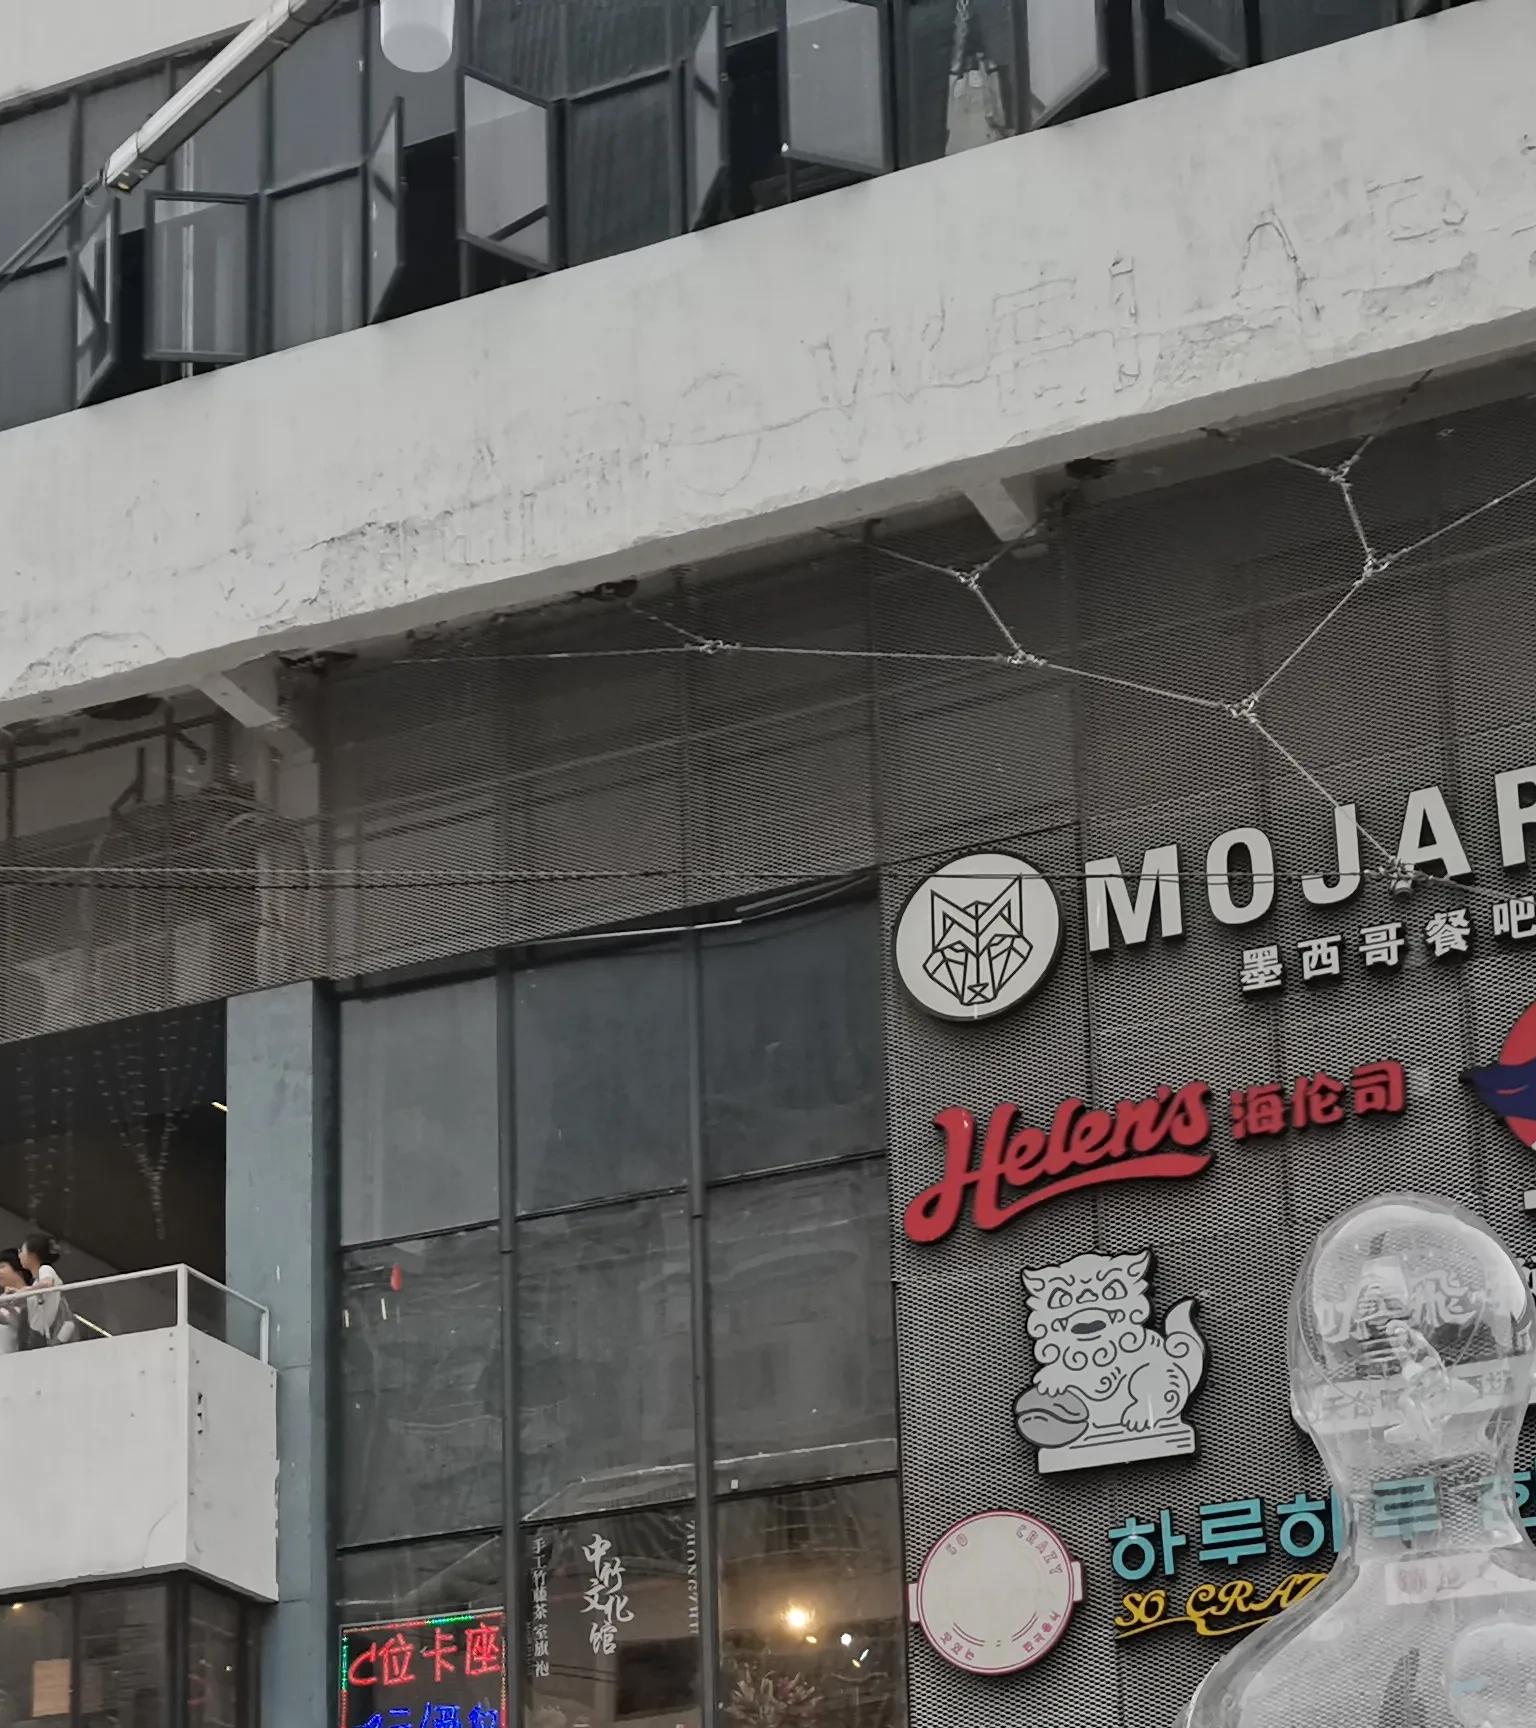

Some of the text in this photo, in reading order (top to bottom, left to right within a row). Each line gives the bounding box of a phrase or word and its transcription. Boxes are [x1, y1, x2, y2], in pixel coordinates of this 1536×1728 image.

[902, 1058, 1407, 1243] Helen's 海伦司
[1015, 1524, 1064, 1576] CRAZY
[1184, 1571, 1330, 1634] CRAZ
[347, 1621, 502, 1687] C位卡座
